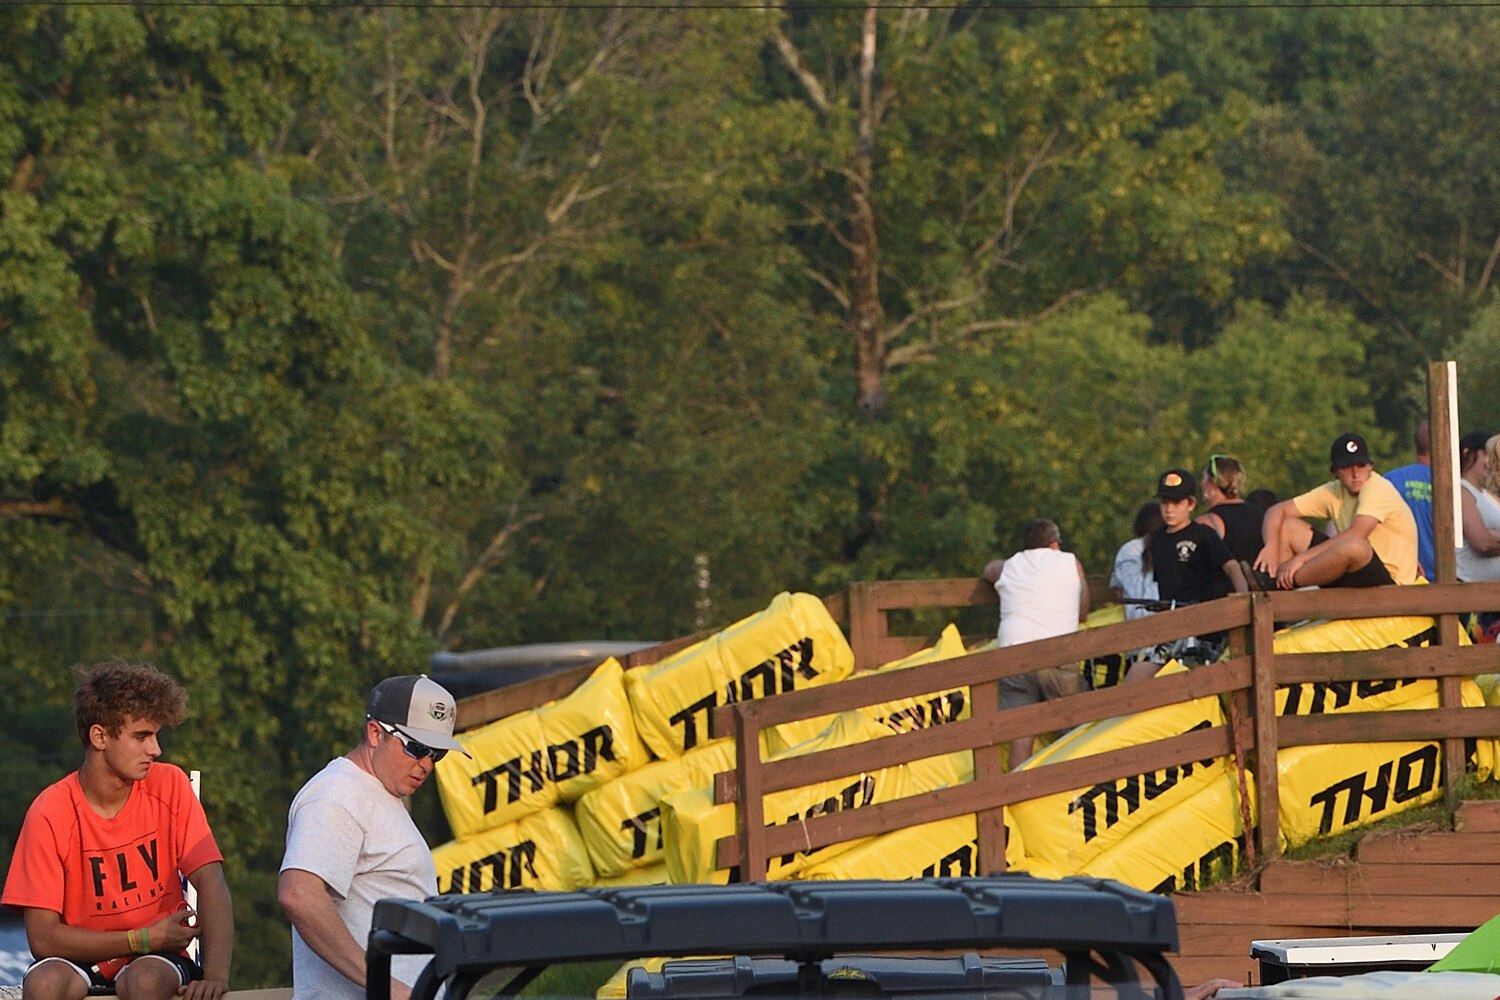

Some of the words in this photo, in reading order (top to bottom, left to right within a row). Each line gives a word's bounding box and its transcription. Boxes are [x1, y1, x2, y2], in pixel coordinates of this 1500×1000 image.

[471, 724, 616, 815] THOR
[1309, 744, 1445, 834] THO
[88, 838, 159, 897] FLY
[96, 882, 164, 911] RACING
